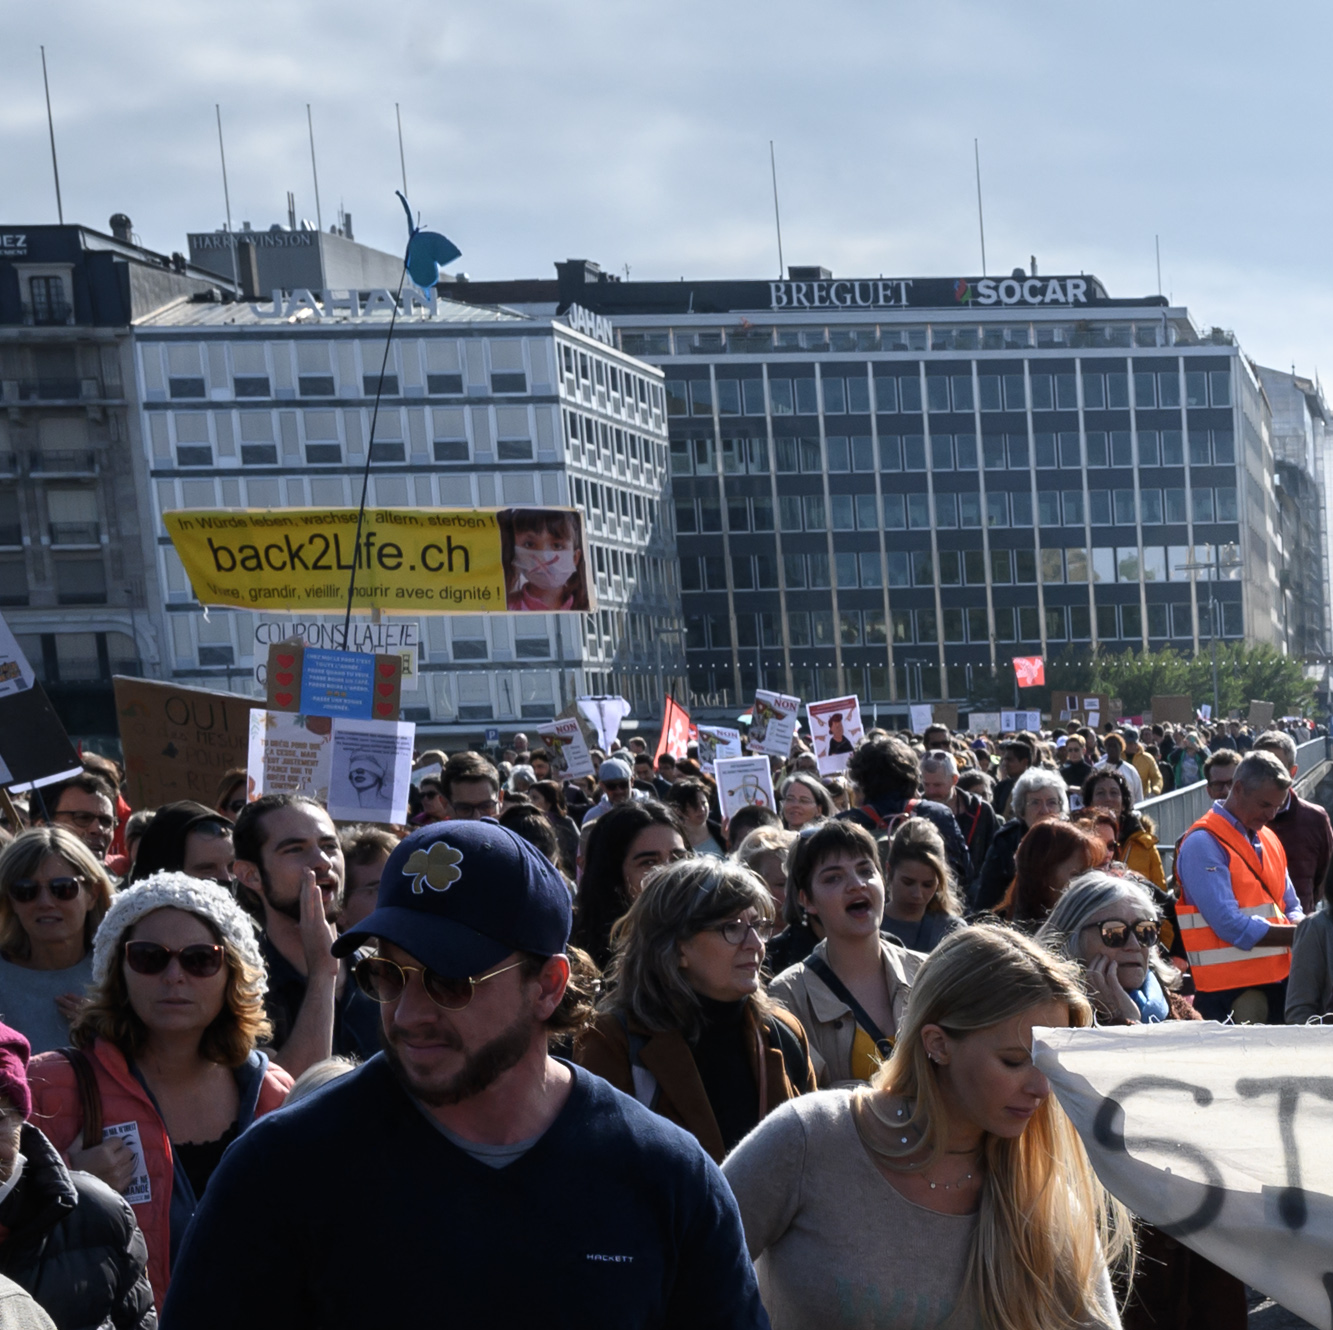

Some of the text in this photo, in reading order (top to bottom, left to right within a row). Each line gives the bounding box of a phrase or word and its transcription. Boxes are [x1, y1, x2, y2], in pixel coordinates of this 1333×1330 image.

[0, 234, 27, 248] EZ
[193, 234, 240, 249] HARRY
[769, 280, 913, 308] BREGUET
[977, 279, 1088, 304] SOCAR
[250, 288, 439, 318] JAHAN
[567, 303, 613, 344] JAHAN
[178, 518, 193, 530] In
[198, 516, 247, 529] Würde
[250, 515, 298, 527] leben,
[375, 511, 424, 526] altern,
[428, 515, 486, 528] sterben
[206, 531, 470, 573] back2Life.ch
[249, 585, 300, 602] grandir,
[304, 584, 343, 599] vieillir,
[395, 587, 434, 599] avec
[439, 586, 491, 603] dignité
[689, 689, 730, 709] PIAGET
[774, 699, 797, 712] NON
[165, 695, 229, 732] OUI
[555, 723, 577, 734] NON
[716, 729, 738, 739] NON
[586, 1253, 634, 1263] HACKETT
